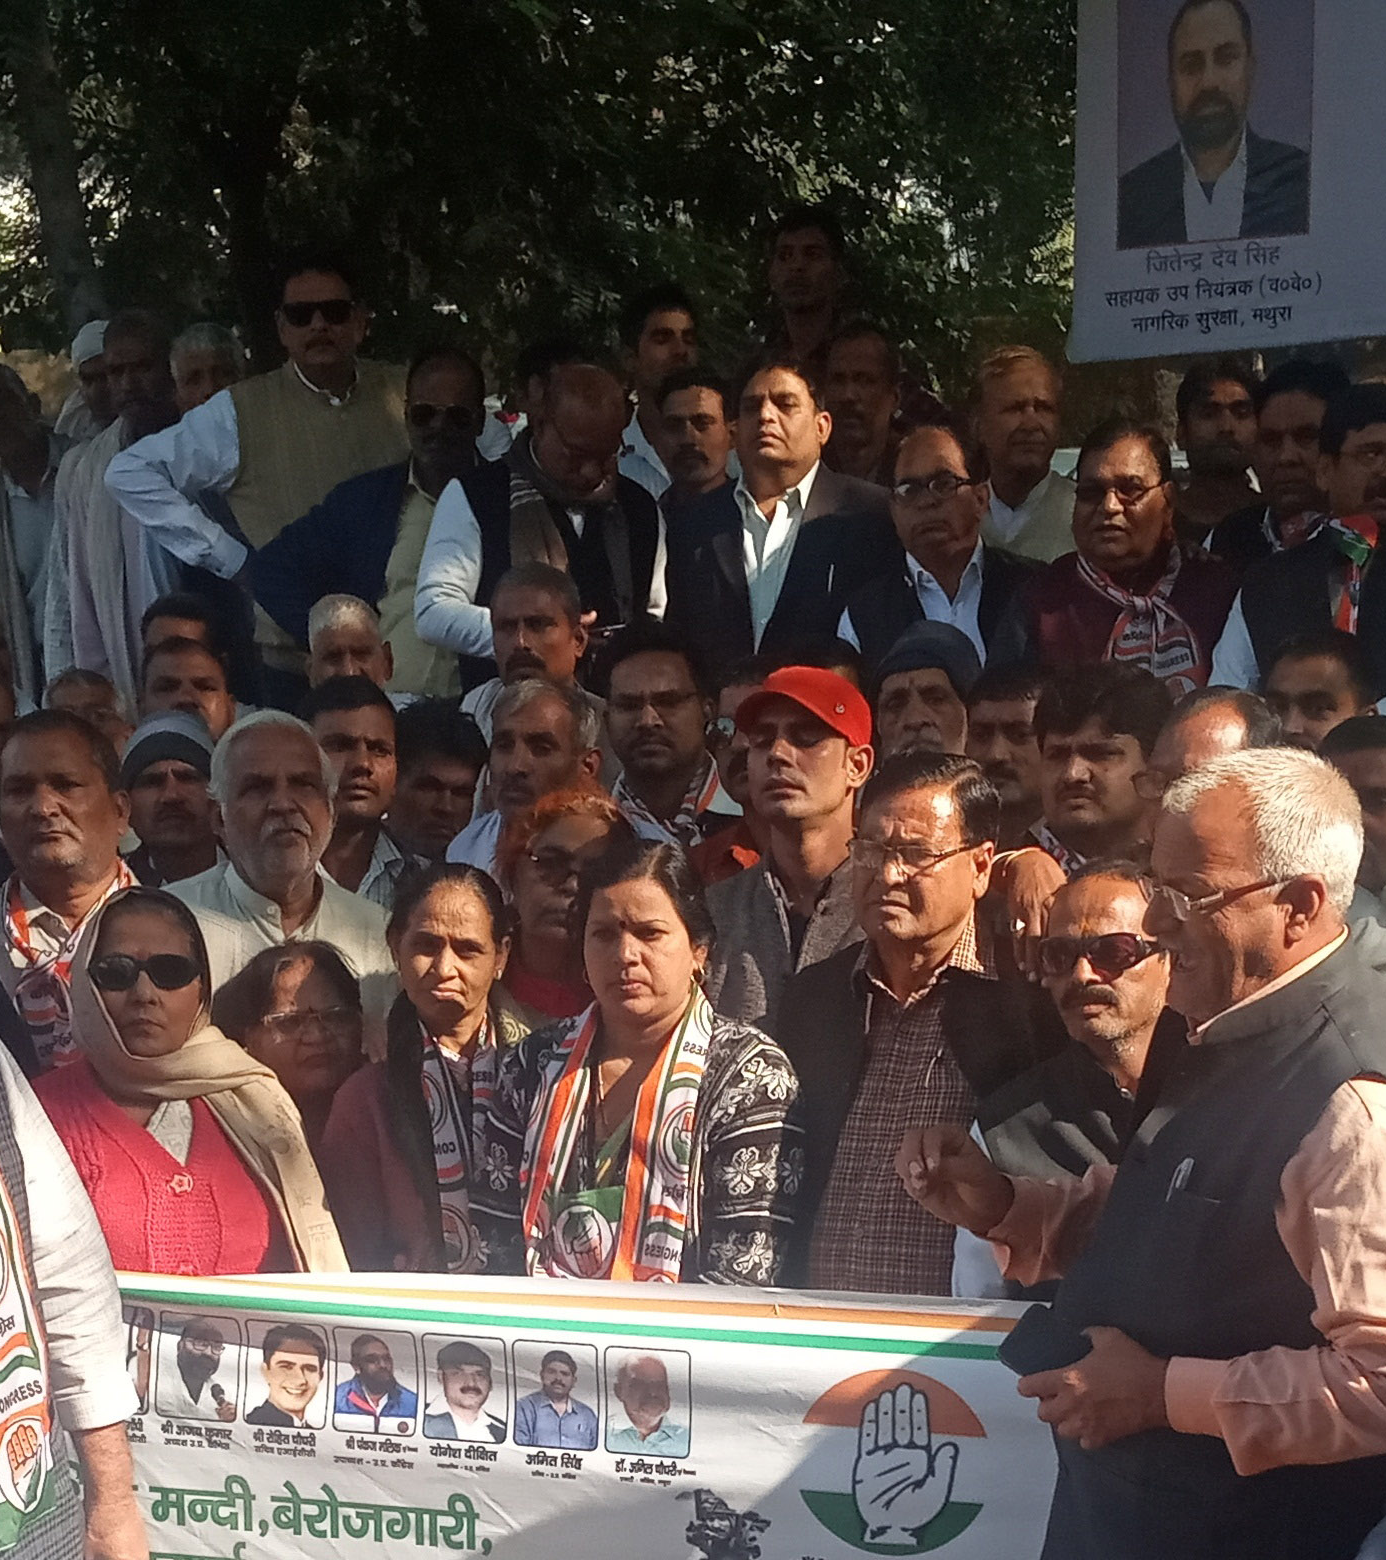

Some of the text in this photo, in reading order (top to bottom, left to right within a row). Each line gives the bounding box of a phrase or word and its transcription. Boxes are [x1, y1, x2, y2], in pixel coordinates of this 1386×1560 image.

[1146, 248, 1203, 274] जितेन्द्र
[1212, 246, 1237, 268] देव
[1104, 287, 1161, 308] सहायक
[1166, 285, 1190, 301] उप
[1196, 277, 1254, 299] नियंत्रक
[1131, 309, 1189, 333] नागरिक
[1251, 305, 1293, 329] मथुरा
[429, 1442, 462, 1459] योगेश
[464, 1445, 498, 1462] दीक्षित
[525, 1451, 583, 1470] अमित सिंह
